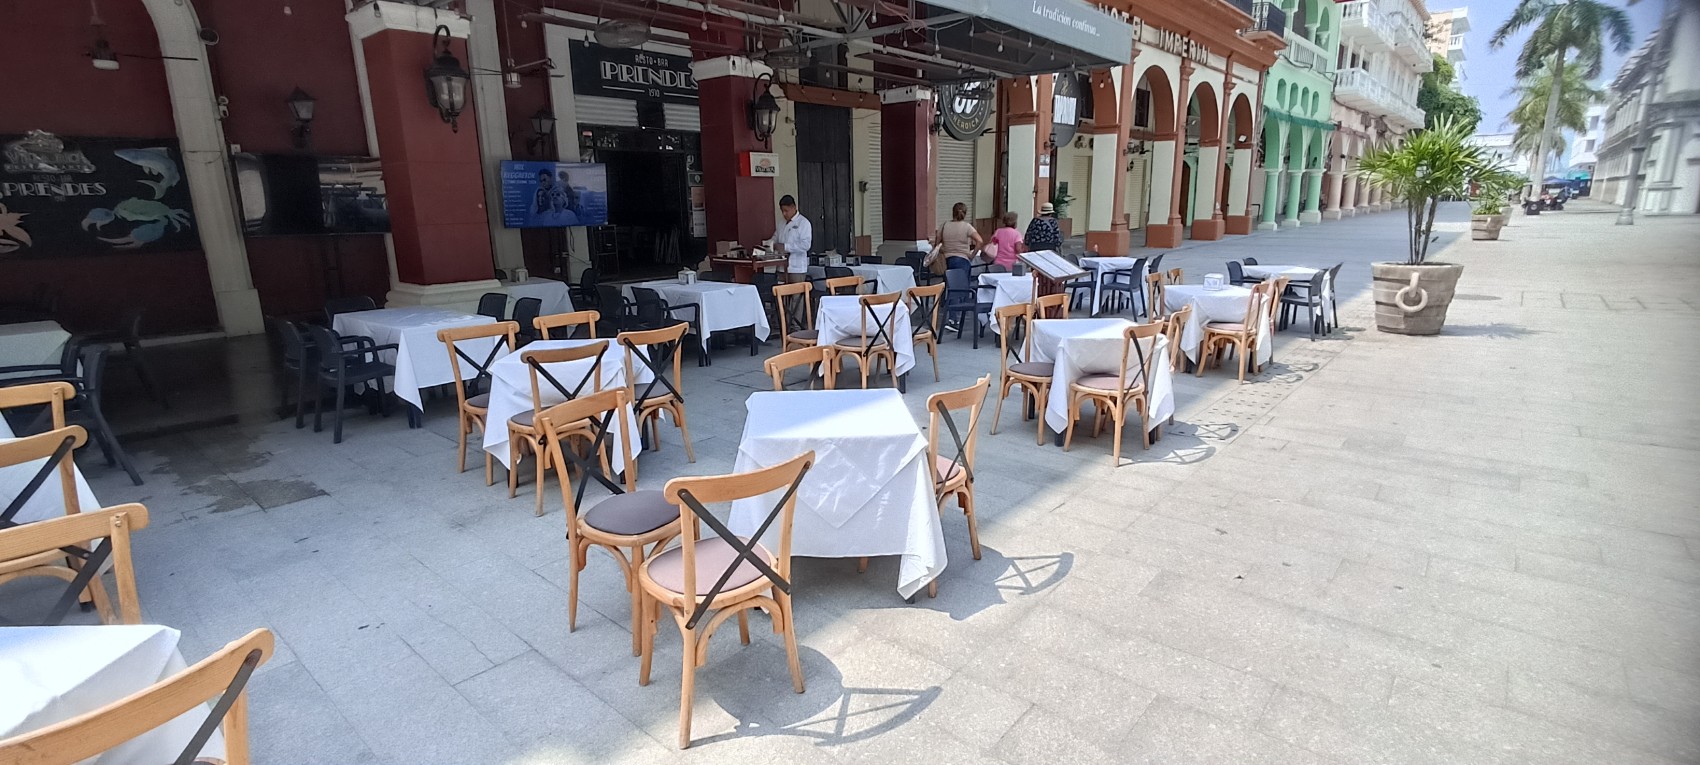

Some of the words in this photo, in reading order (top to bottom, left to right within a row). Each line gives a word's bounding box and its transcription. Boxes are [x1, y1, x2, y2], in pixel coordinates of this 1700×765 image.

[1032, 0, 1042, 15] La
[1043, 5, 1072, 26] tradición
[1159, 26, 1211, 66] IMPERIAL
[600, 60, 699, 90] PRENDES
[2, 182, 107, 197] PRENDES
